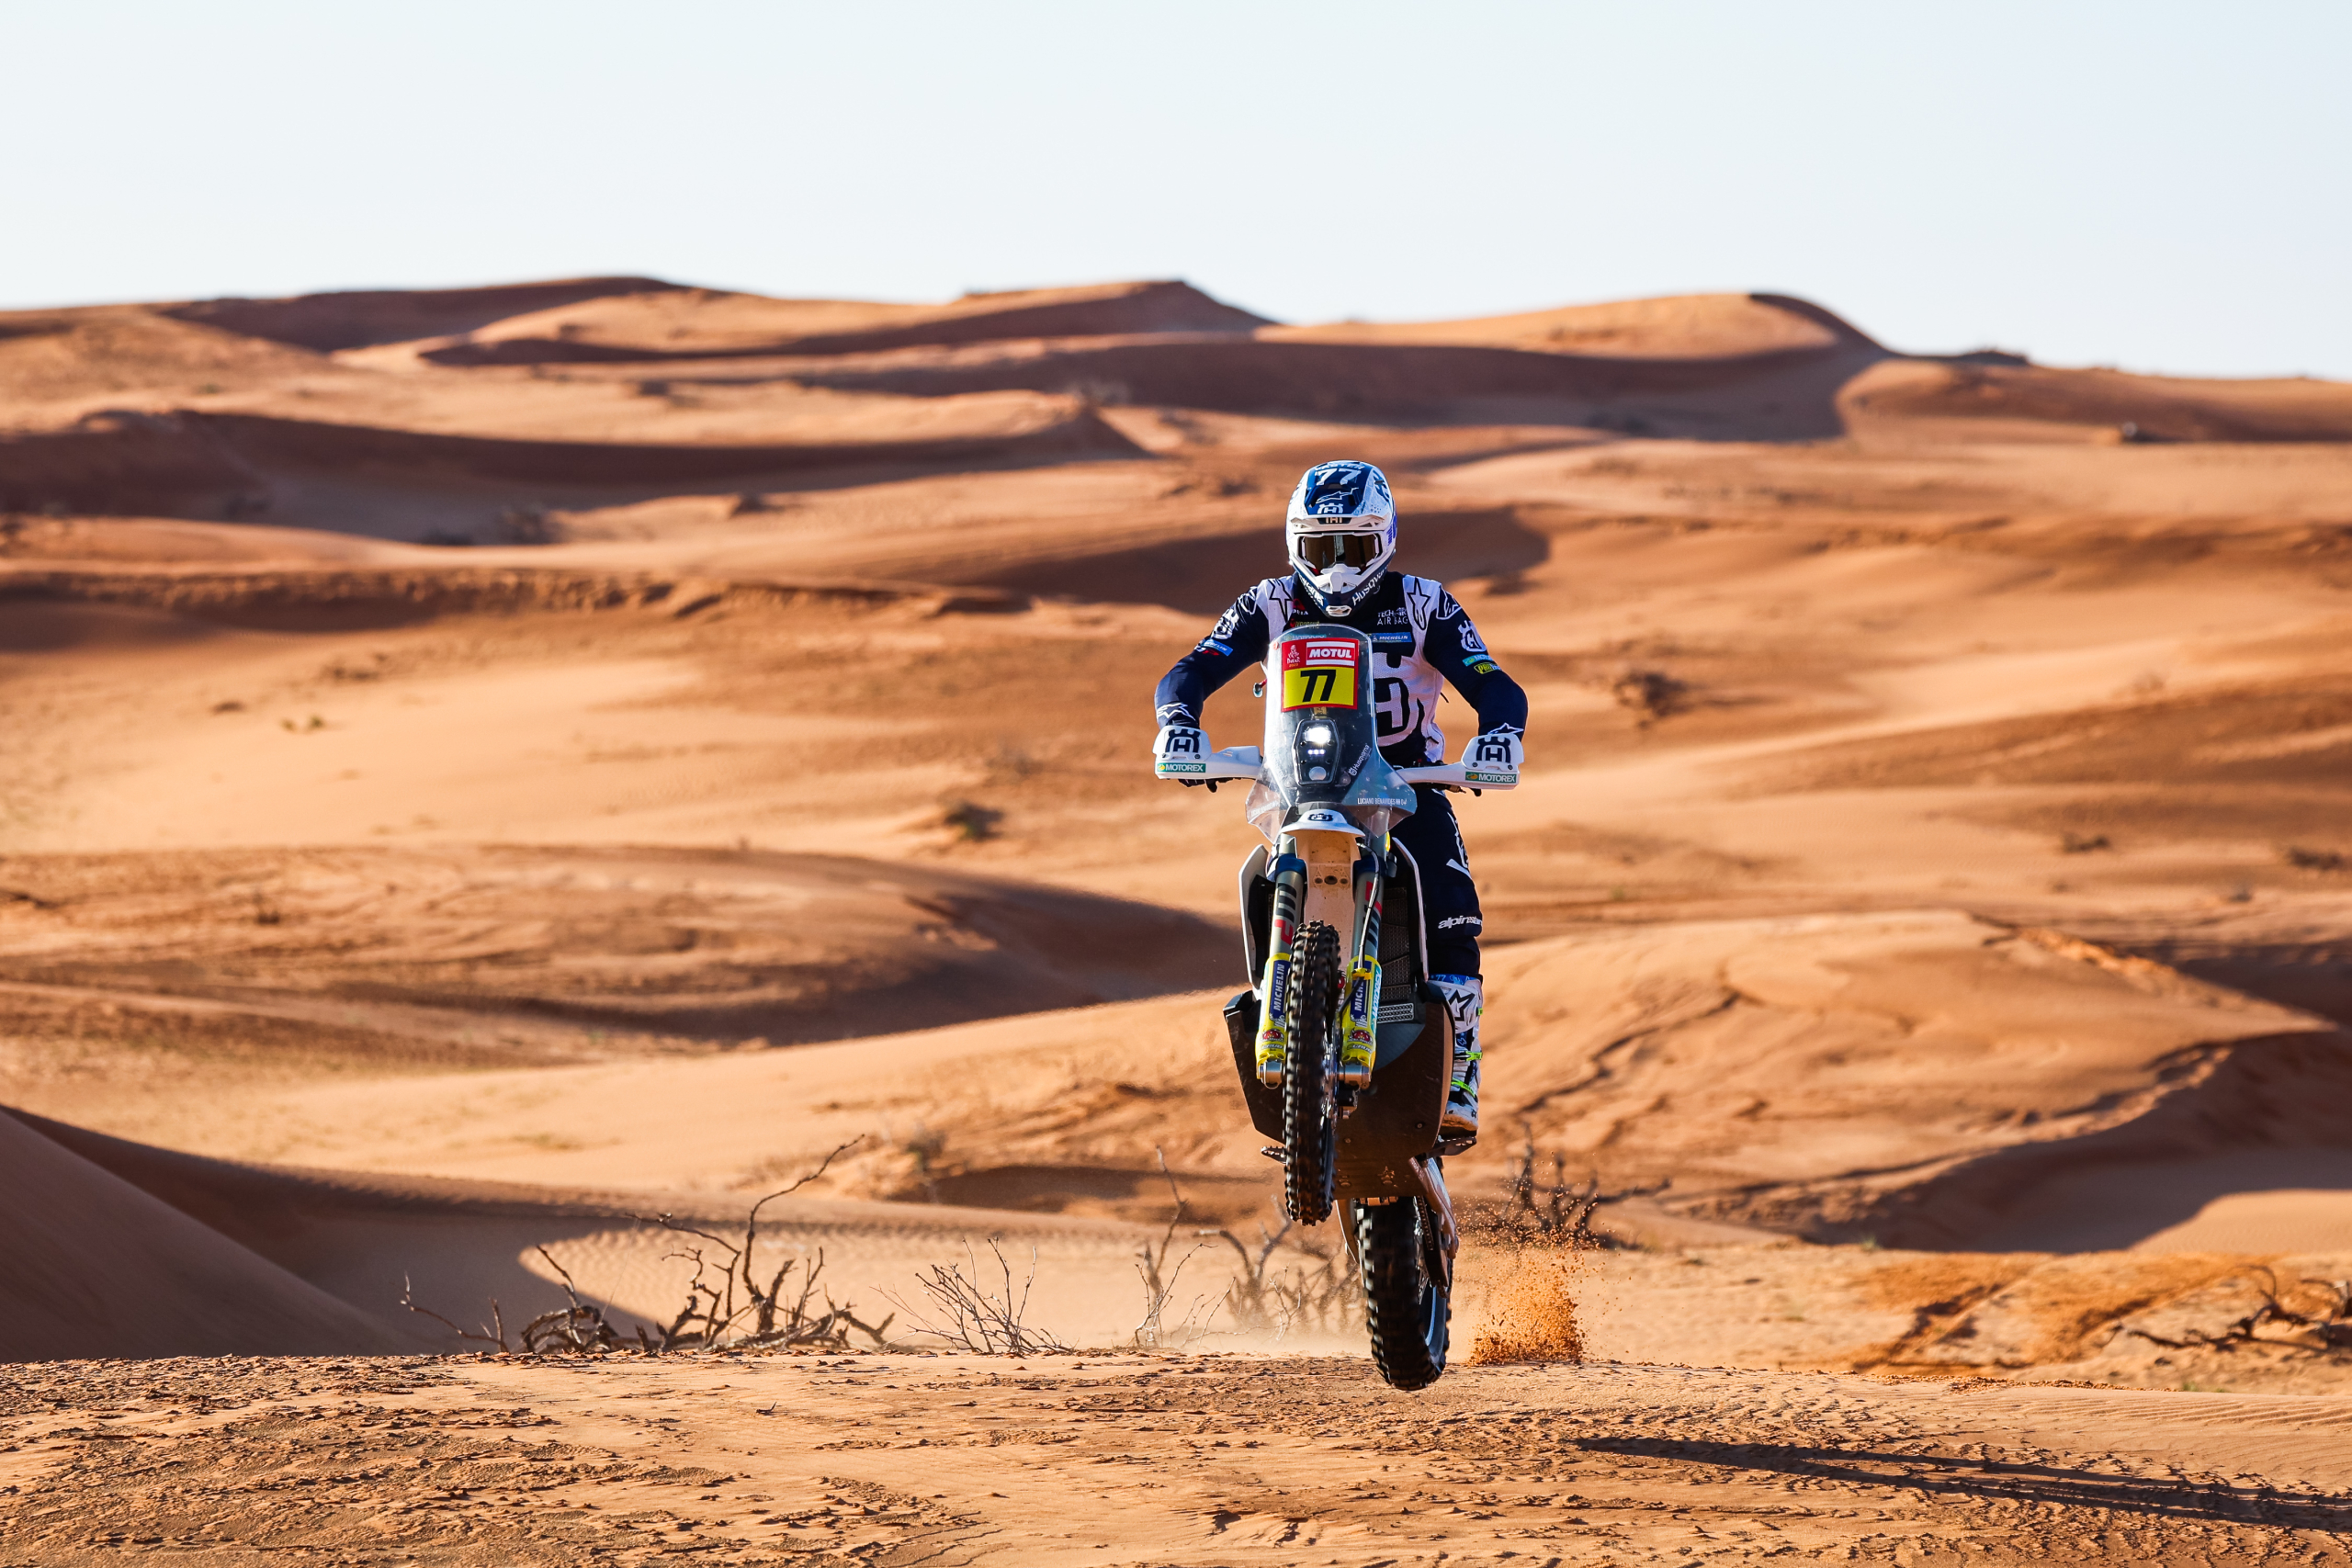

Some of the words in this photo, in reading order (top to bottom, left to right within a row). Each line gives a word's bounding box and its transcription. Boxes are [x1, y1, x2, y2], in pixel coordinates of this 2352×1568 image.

[1315, 468, 1362, 486] 77
[1351, 567, 1385, 606] Husqva
[1377, 616, 1392, 626] AIR
[1394, 616, 1408, 625] BAG
[1309, 649, 1352, 659] MOTUL
[1300, 670, 1337, 703] 77
[1353, 744, 1370, 771] Husqvarna
[1478, 773, 1516, 783] MOTOREX
[1273, 964, 1285, 1011] MICHELIN
